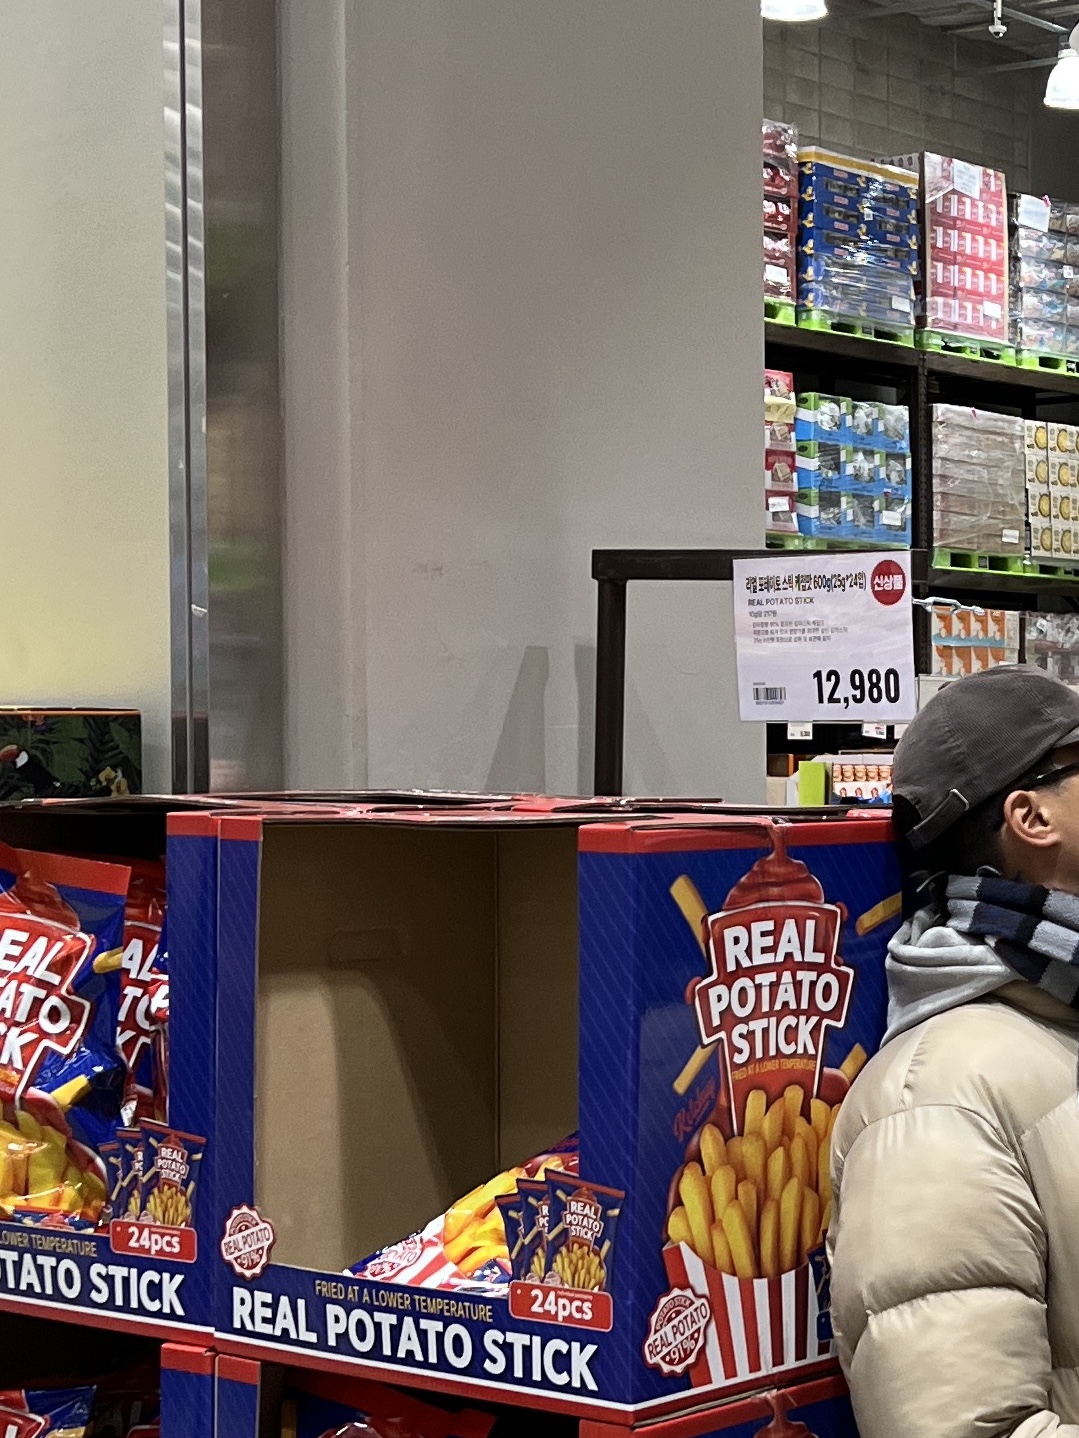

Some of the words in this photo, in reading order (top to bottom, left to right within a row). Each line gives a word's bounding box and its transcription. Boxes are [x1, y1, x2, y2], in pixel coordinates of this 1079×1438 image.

[758, 572, 782, 592] 포테이토
[781, 572, 794, 592] 스틱
[873, 574, 904, 591] 신상품
[747, 597, 765, 607] REAL
[765, 596, 794, 606] POTATO
[794, 596, 815, 605] STICK
[812, 668, 901, 709] 12,980
[723, 918, 826, 973] REAL
[708, 970, 840, 1027] POTATO
[731, 1015, 820, 1065] STICK
[565, 1213, 601, 1233] POTATO
[569, 1200, 598, 1220] REAL
[32, 1234, 98, 1258] TEMPERATURE
[128, 1226, 181, 1254] 24pcs
[570, 1226, 594, 1241] STICK
[0, 1250, 82, 1299] TATO
[89, 1262, 186, 1316] STICK
[315, 1279, 345, 1300] FRIED
[346, 1285, 360, 1301] AT
[362, 1288, 371, 1305] A
[372, 1289, 412, 1311] LOWER
[413, 1294, 494, 1323] TEMPERATURE
[530, 1288, 593, 1322] 24pcs
[232, 1286, 318, 1344] REAL
[325, 1303, 473, 1369] POTATO
[483, 1328, 599, 1392] STICK
[647, 1330, 673, 1360] REAL
[671, 1302, 708, 1341] POTATO
[670, 1335, 696, 1365] 91%
